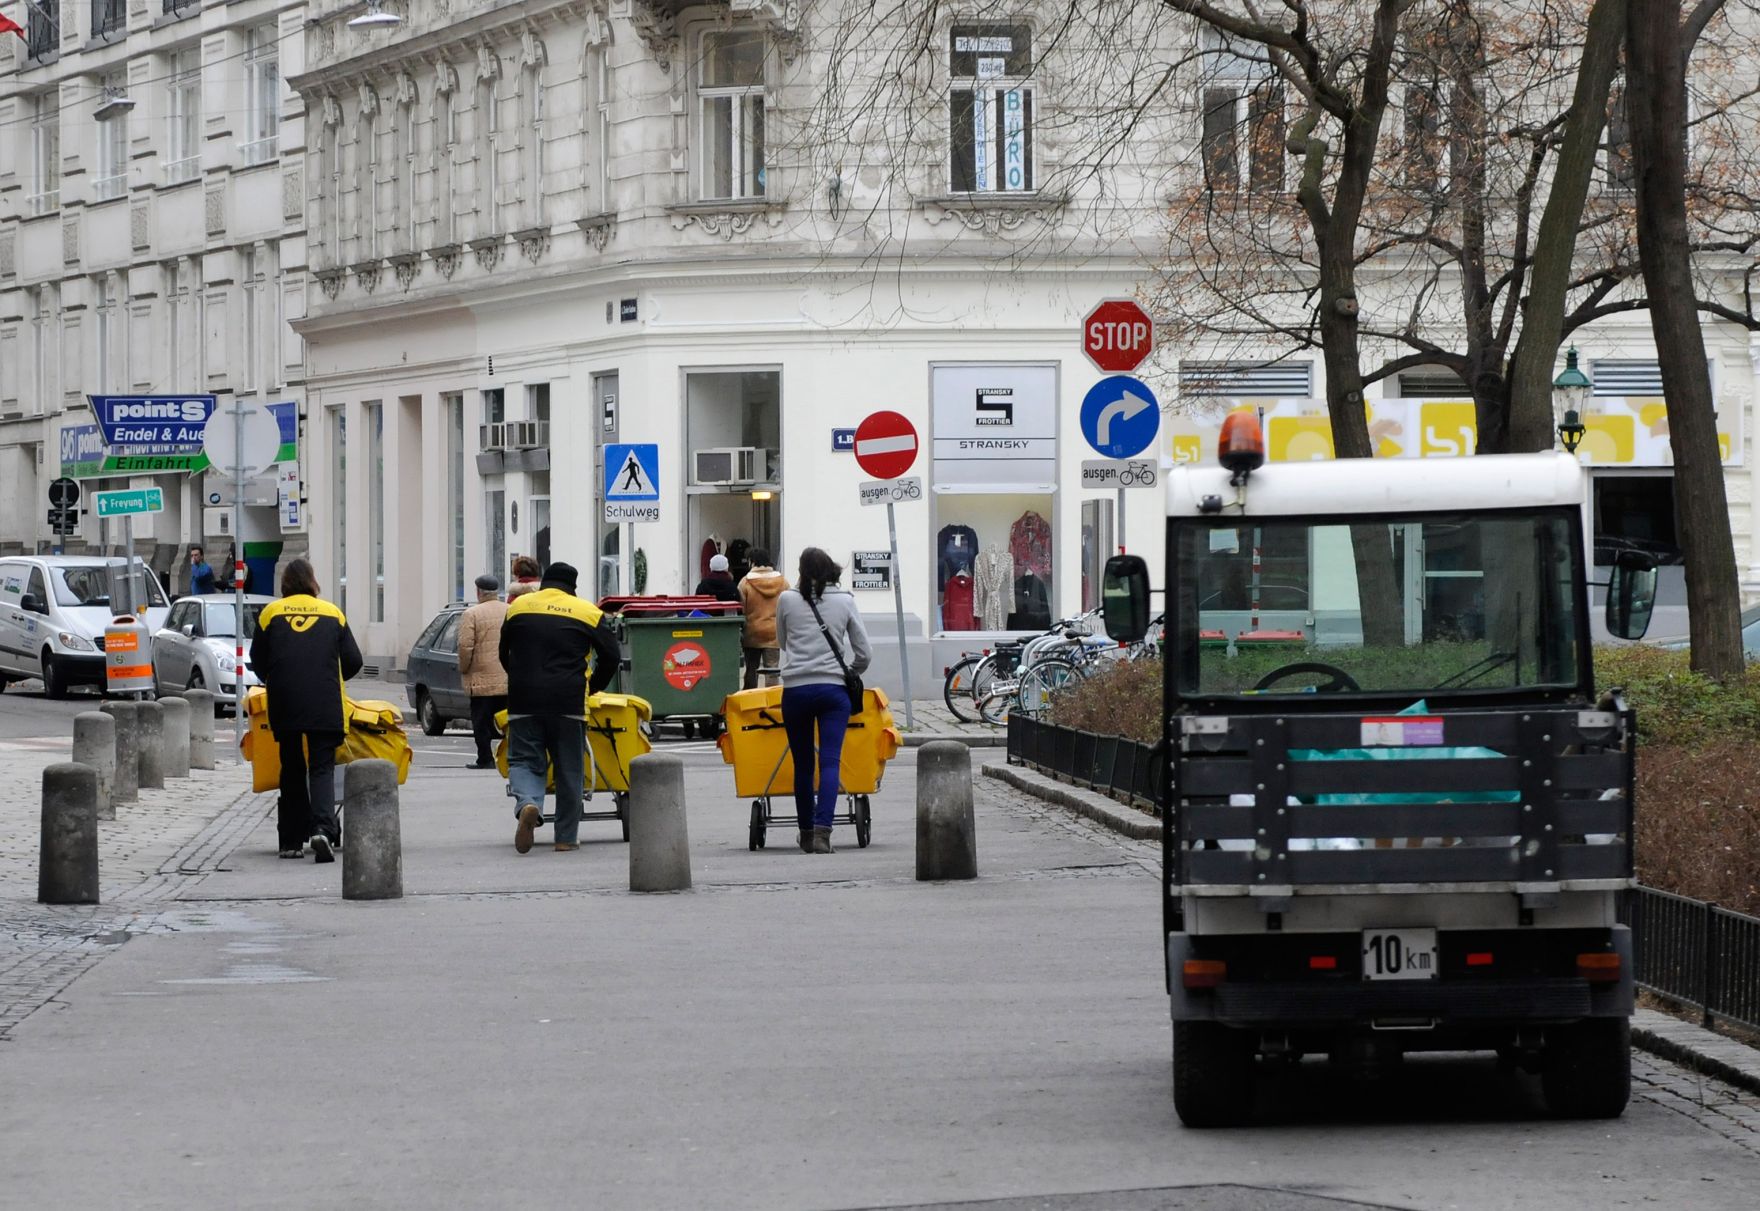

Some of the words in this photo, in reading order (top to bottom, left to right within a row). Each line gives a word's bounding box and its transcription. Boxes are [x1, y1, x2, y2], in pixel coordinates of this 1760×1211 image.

[1007, 91, 1021, 187] BÜRO
[1089, 321, 1147, 351] STOP
[977, 388, 1012, 396] STRANSKY
[113, 427, 159, 442] Endel
[161, 427, 173, 441] &
[61, 429, 75, 461] 96
[959, 440, 1030, 449] STRANSKY
[116, 456, 192, 470] Einfahrt
[1083, 468, 1119, 482] ausgen.
[110, 498, 143, 510] Freyung
[605, 505, 660, 520] Schulweg
[855, 552, 889, 560] STRANSKY
[546, 604, 573, 614] Post
[1368, 934, 1402, 975] 10
[1405, 946, 1432, 970] km
